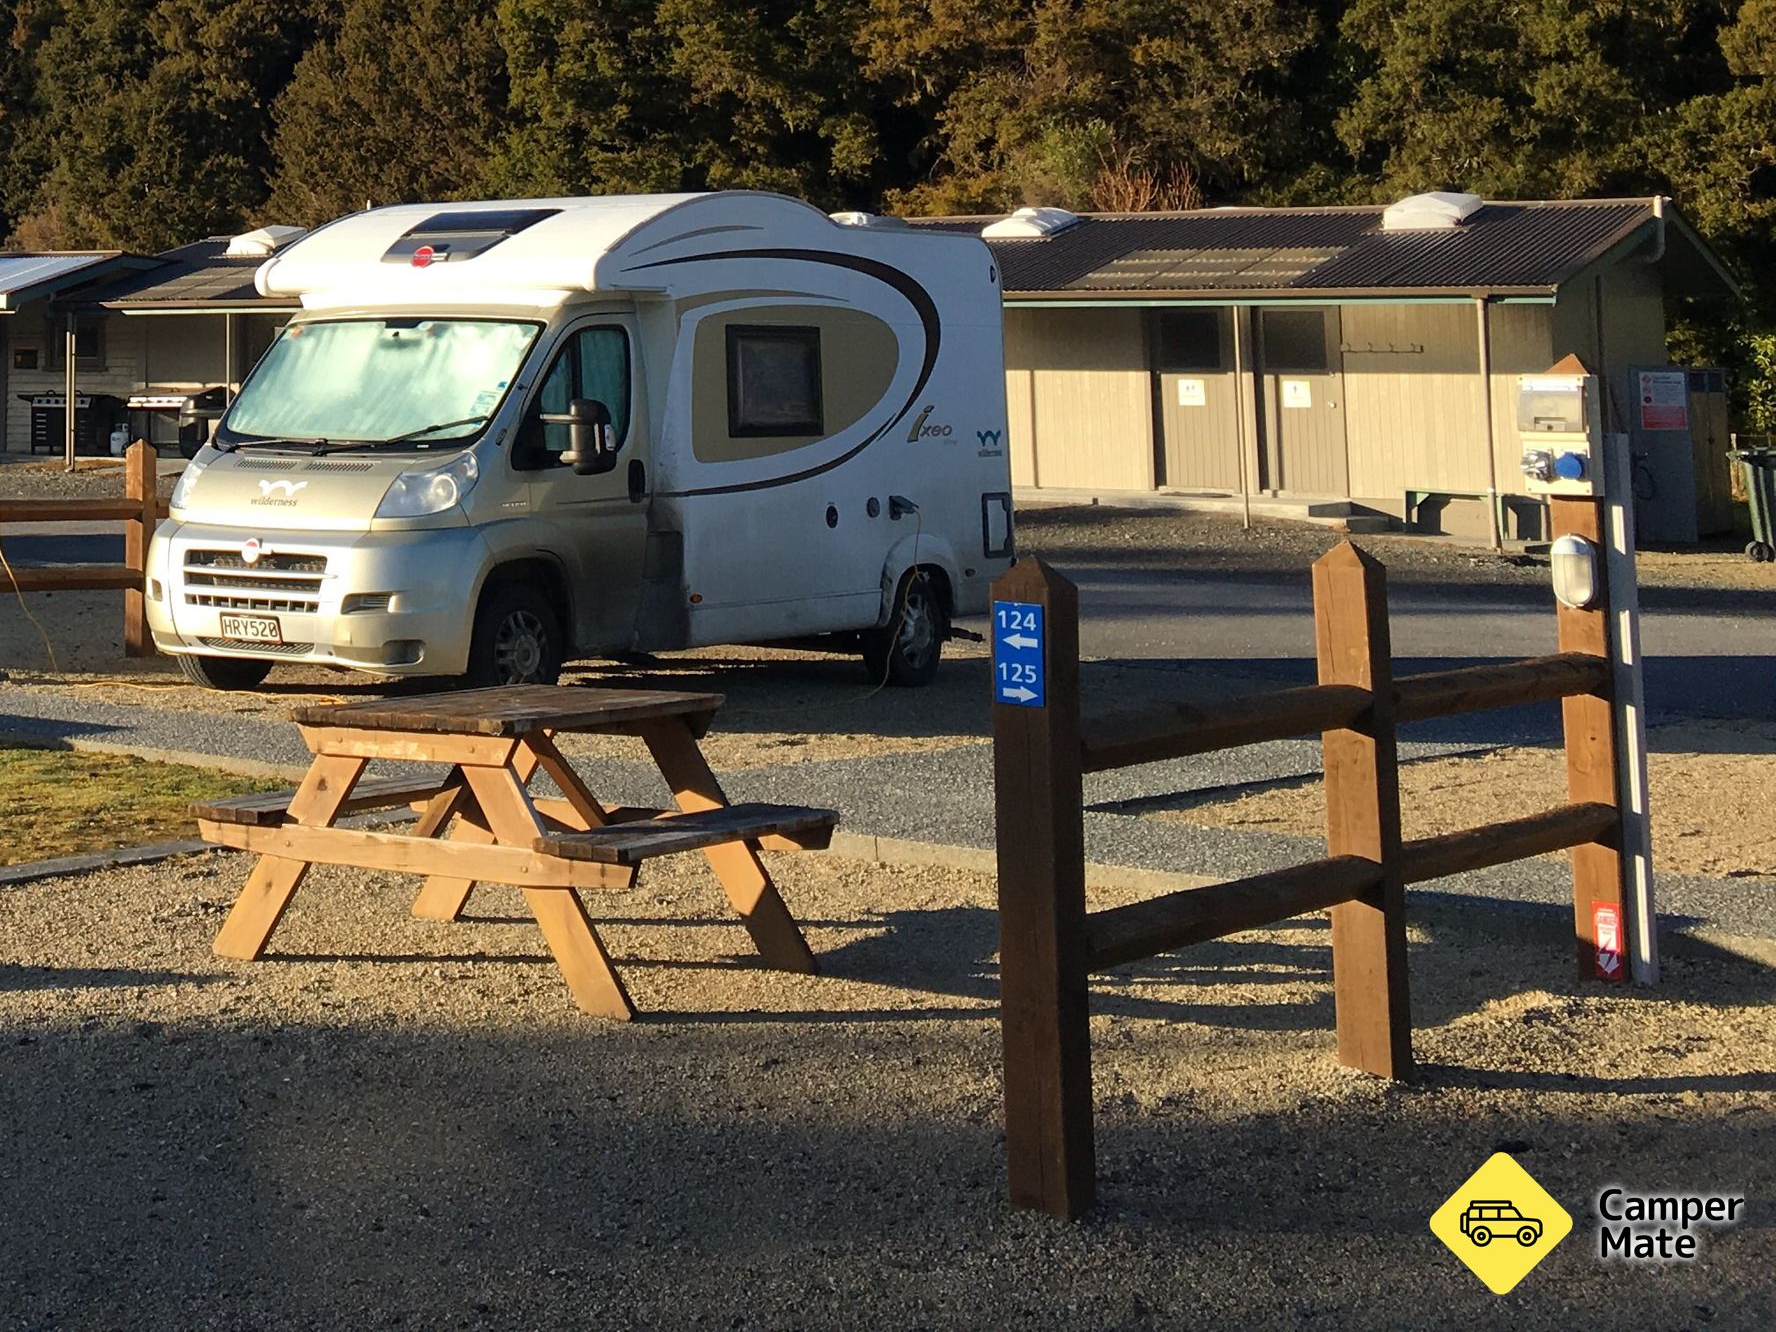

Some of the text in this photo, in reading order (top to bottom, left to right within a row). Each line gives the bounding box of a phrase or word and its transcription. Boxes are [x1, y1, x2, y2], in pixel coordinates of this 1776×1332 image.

[250, 496, 298, 507] wilderness
[224, 618, 278, 638] HRY520
[998, 610, 1037, 632] 124
[998, 662, 1037, 684] 125
